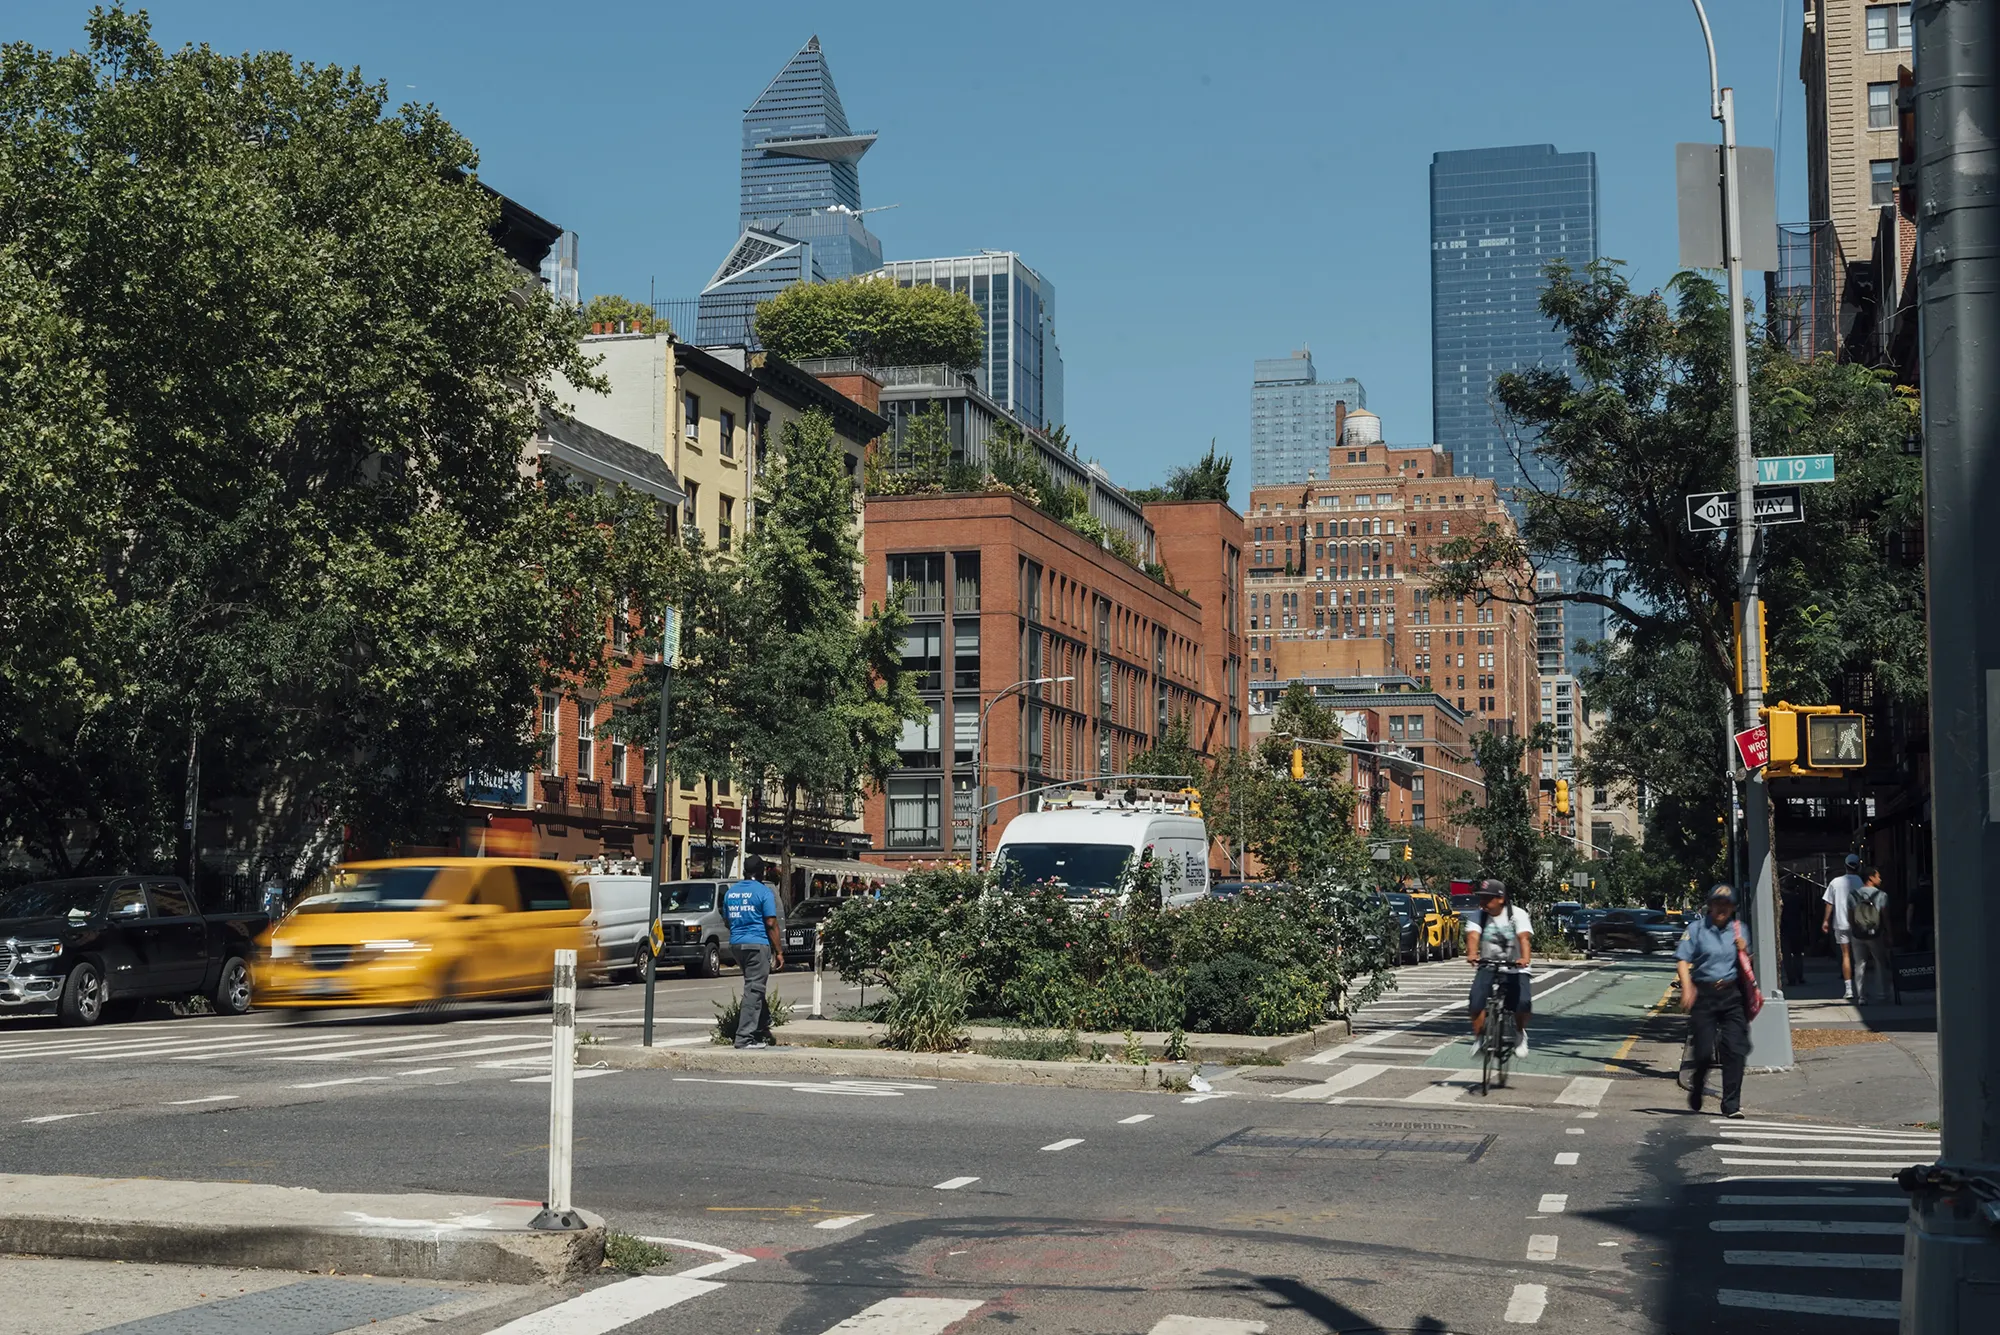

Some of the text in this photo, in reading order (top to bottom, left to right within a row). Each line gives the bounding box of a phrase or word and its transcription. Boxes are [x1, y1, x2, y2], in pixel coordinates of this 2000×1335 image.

[1764, 459, 1826, 480] W 19 ST
[1706, 498, 1785, 518] ONE WAY
[1748, 738, 1768, 753] WRO
